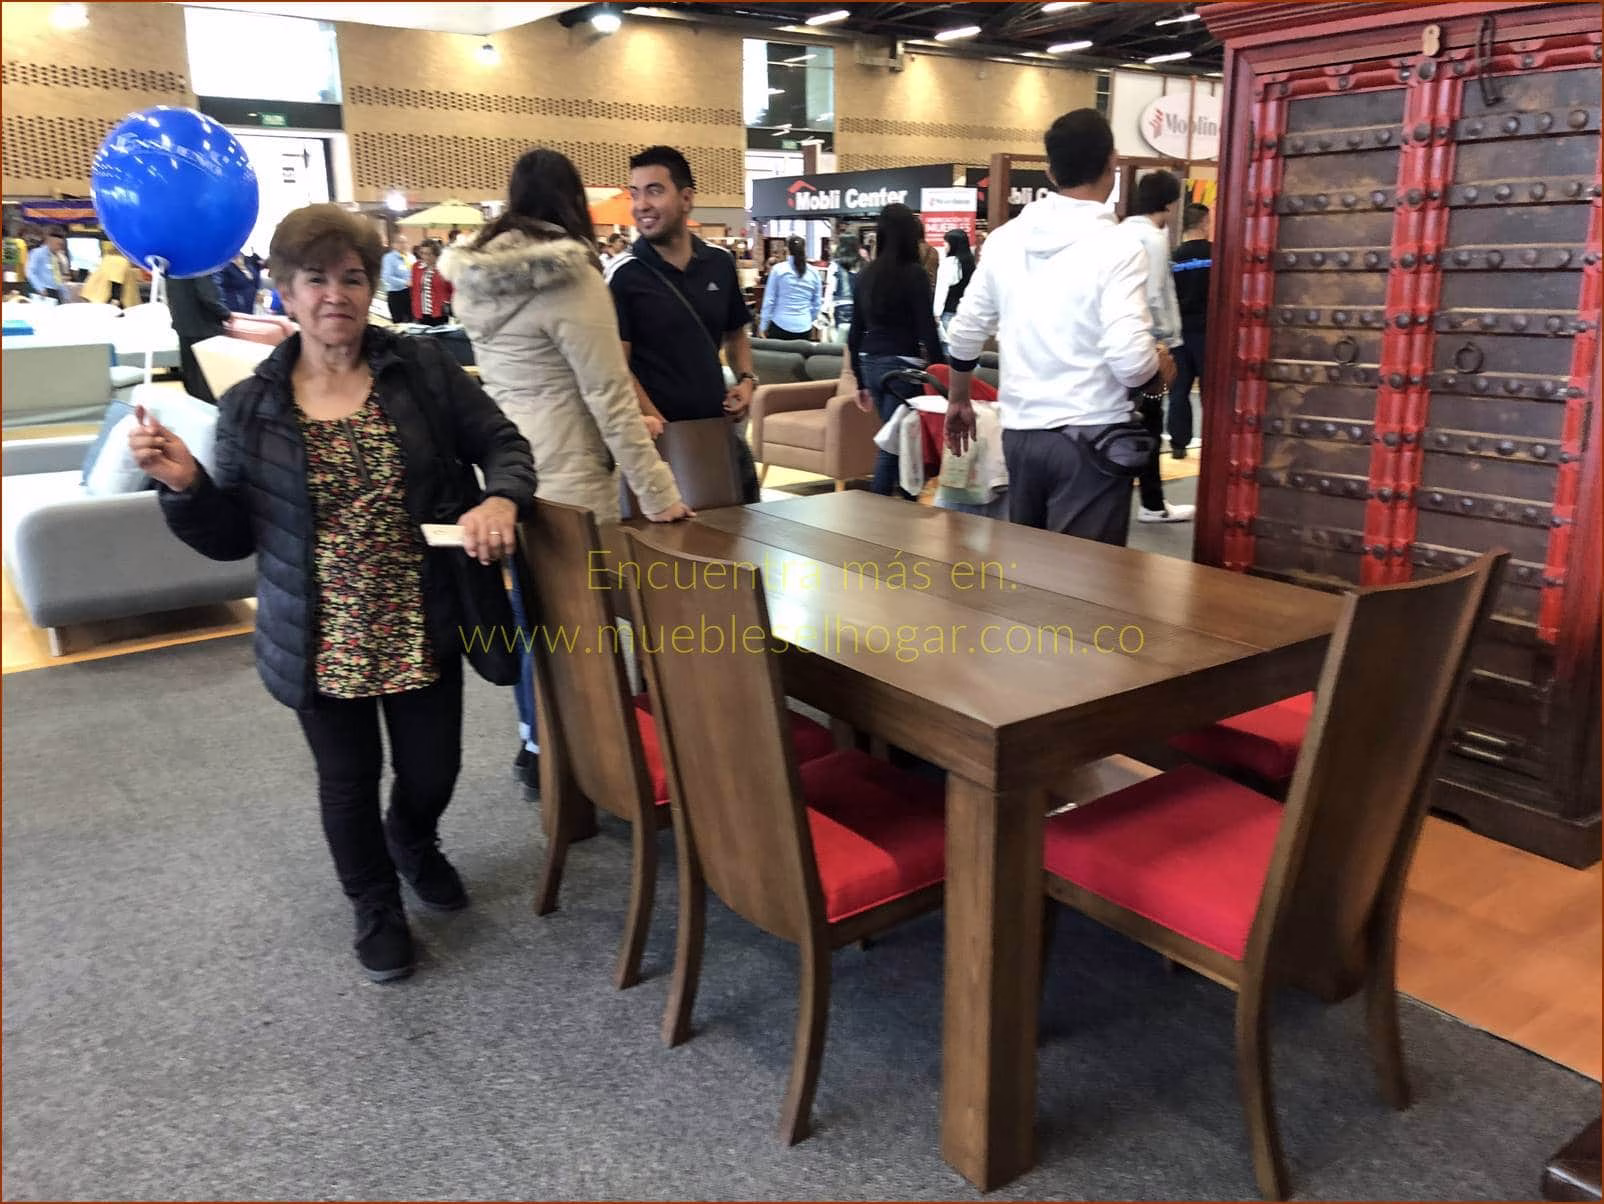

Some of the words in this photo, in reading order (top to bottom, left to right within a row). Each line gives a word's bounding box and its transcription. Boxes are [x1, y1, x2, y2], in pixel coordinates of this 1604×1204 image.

[1165, 113, 1217, 136] Molin
[795, 190, 841, 210] Mobli
[845, 187, 908, 208] Center
[1008, 187, 1033, 205] bli
